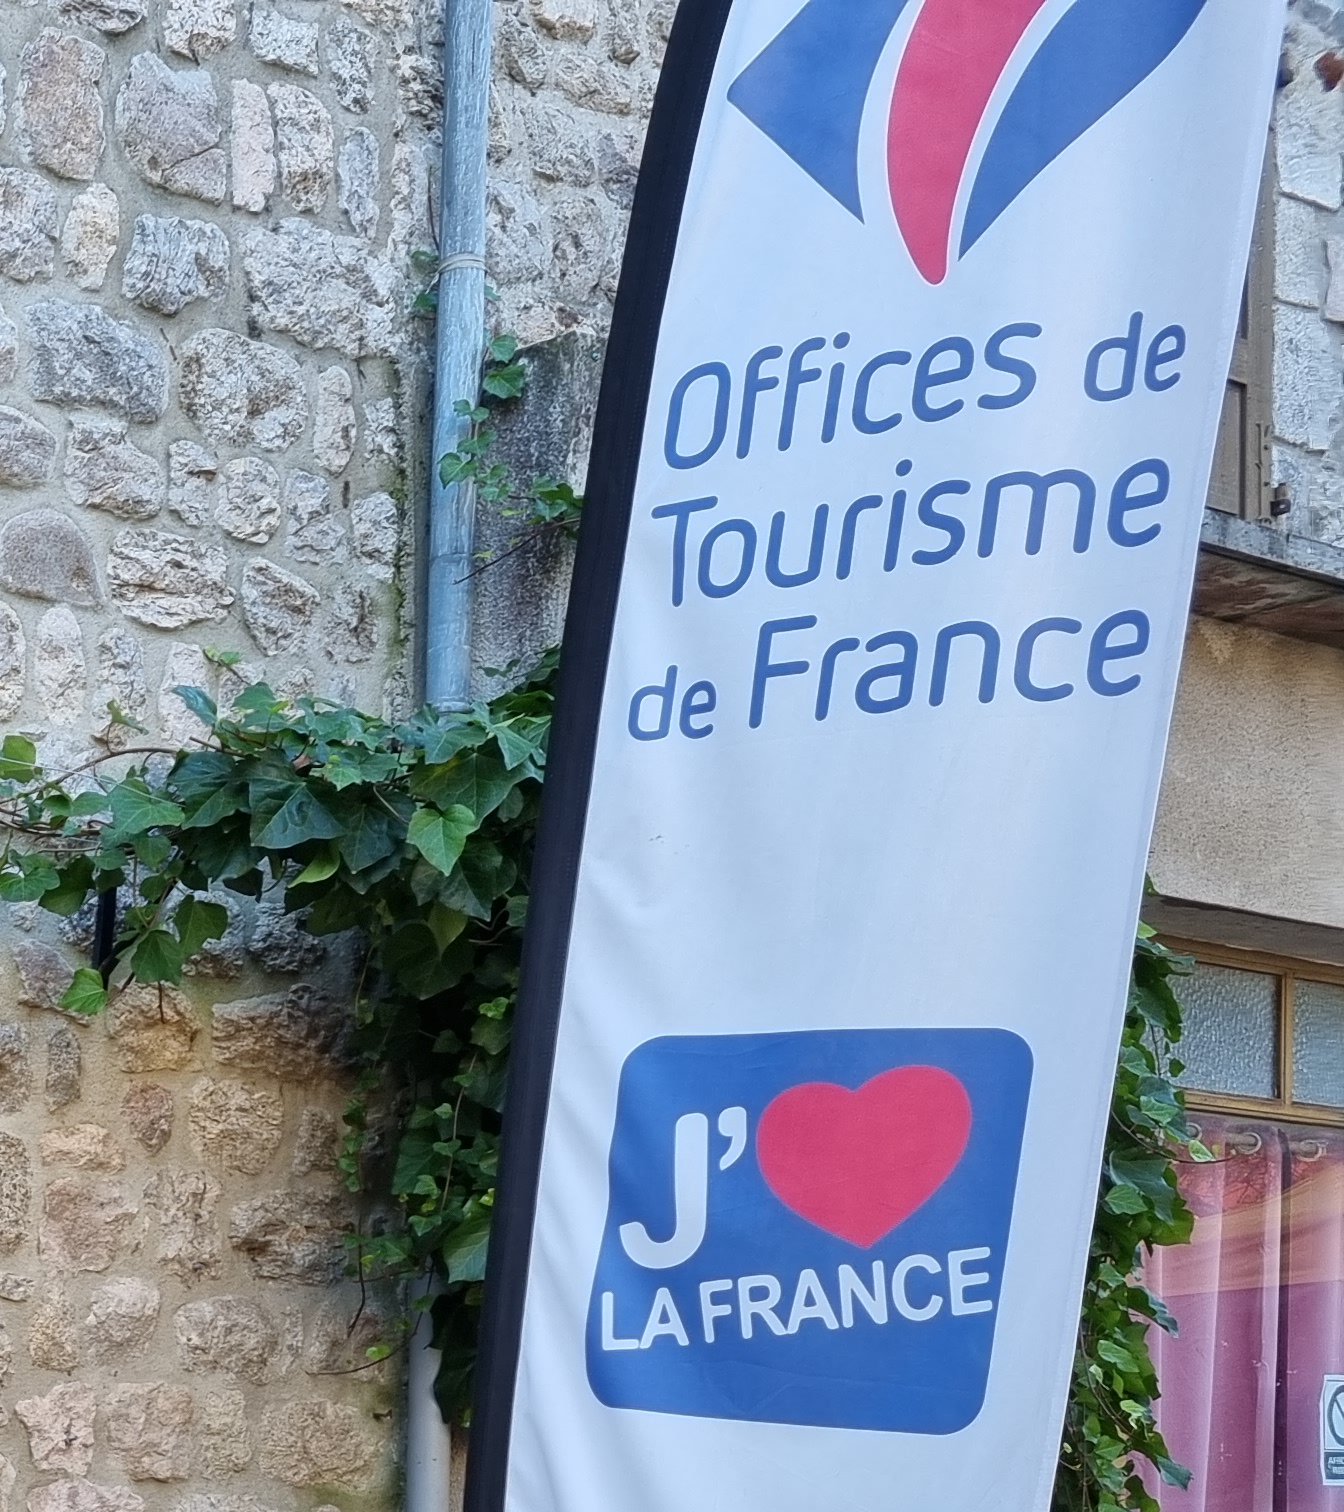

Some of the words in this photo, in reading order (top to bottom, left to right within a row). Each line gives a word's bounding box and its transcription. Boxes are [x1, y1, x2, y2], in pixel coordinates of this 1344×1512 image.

[662, 321, 1045, 471] Offices
[1082, 310, 1188, 402] de
[651, 457, 1171, 608] Tourisme
[626, 663, 718, 743] de
[747, 607, 1152, 730] France
[617, 1105, 749, 1270] J'
[599, 1285, 690, 1353] LA
[698, 1246, 994, 1345] FRANCE
